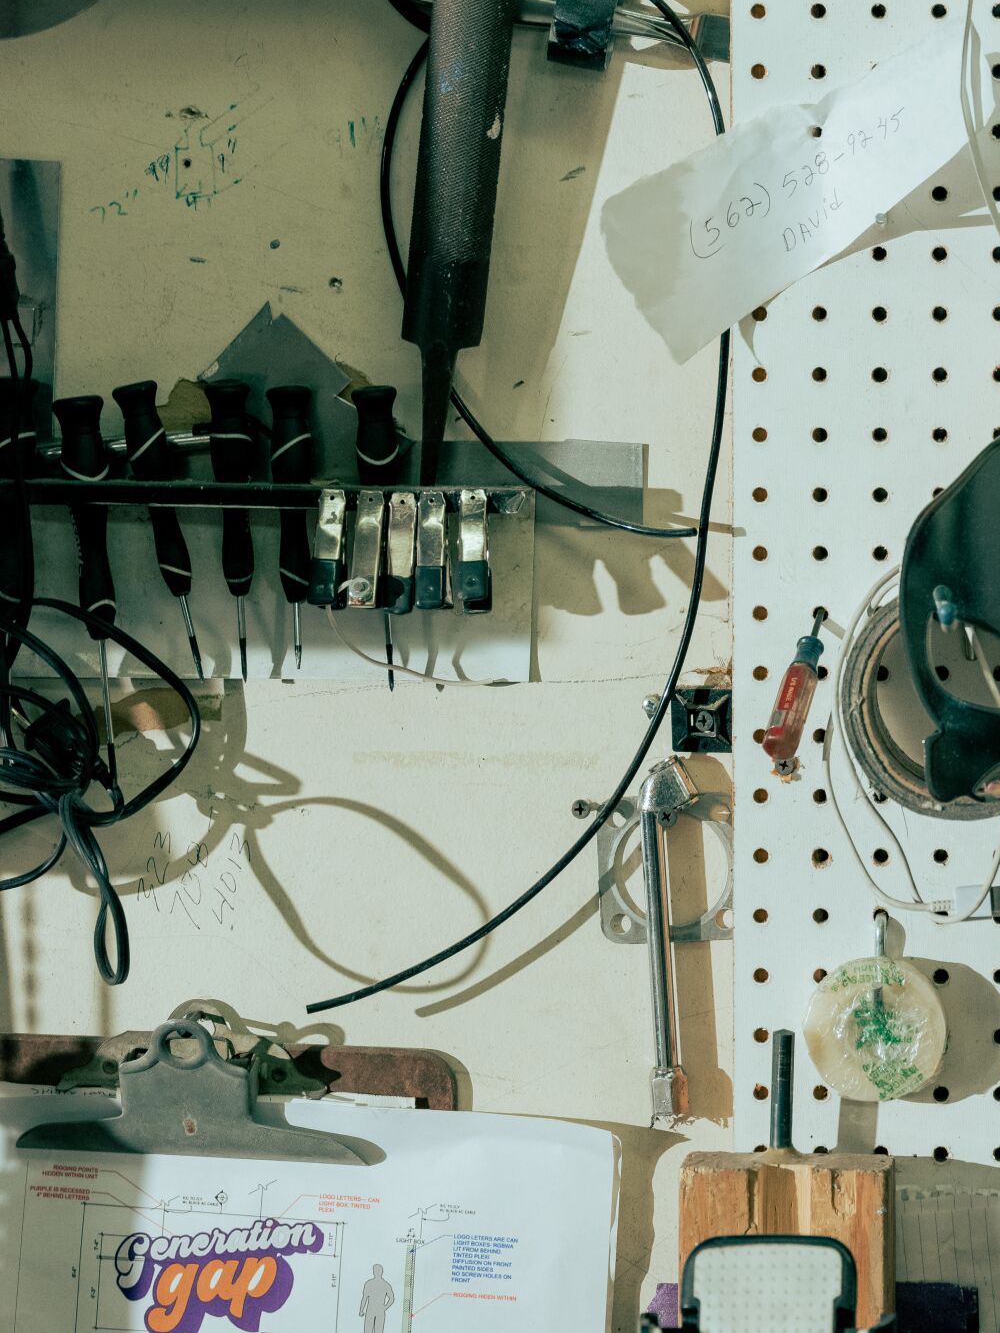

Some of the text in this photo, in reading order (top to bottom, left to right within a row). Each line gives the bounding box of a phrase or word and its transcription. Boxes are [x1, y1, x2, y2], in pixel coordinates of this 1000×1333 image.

[60, 1187, 90, 1195] RECESSED
[115, 1218, 318, 1292] Generation
[146, 1256, 279, 1333] gap
